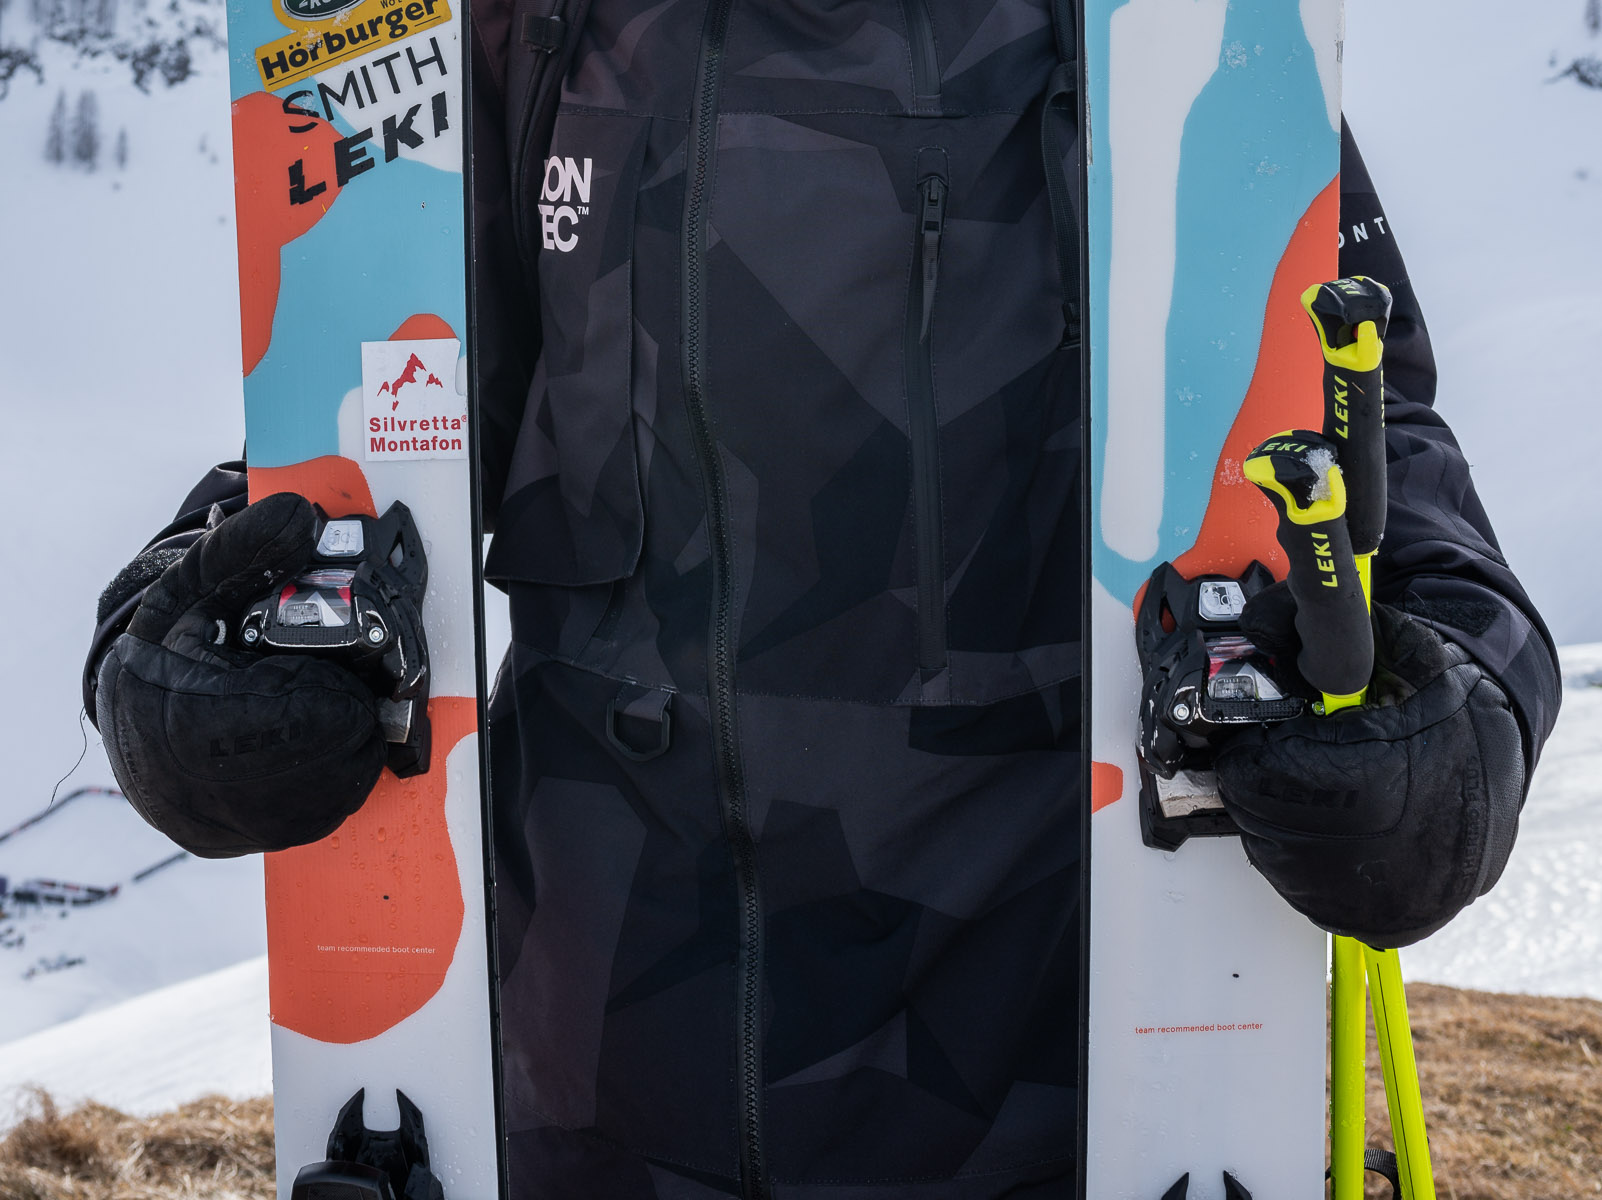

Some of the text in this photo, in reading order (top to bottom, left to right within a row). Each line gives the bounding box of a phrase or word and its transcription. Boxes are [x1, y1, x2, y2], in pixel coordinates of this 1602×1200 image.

[282, 36, 448, 134] SMITH
[287, 90, 450, 206] LEKI
[541, 155, 593, 203] ON
[1334, 374, 1349, 440] LEKI
[370, 435, 462, 453] Montafon
[1311, 532, 1339, 588] LEKI
[317, 944, 336, 952] team
[337, 945, 391, 953] recommended
[1135, 1022, 1264, 1034] team recommended boot center
